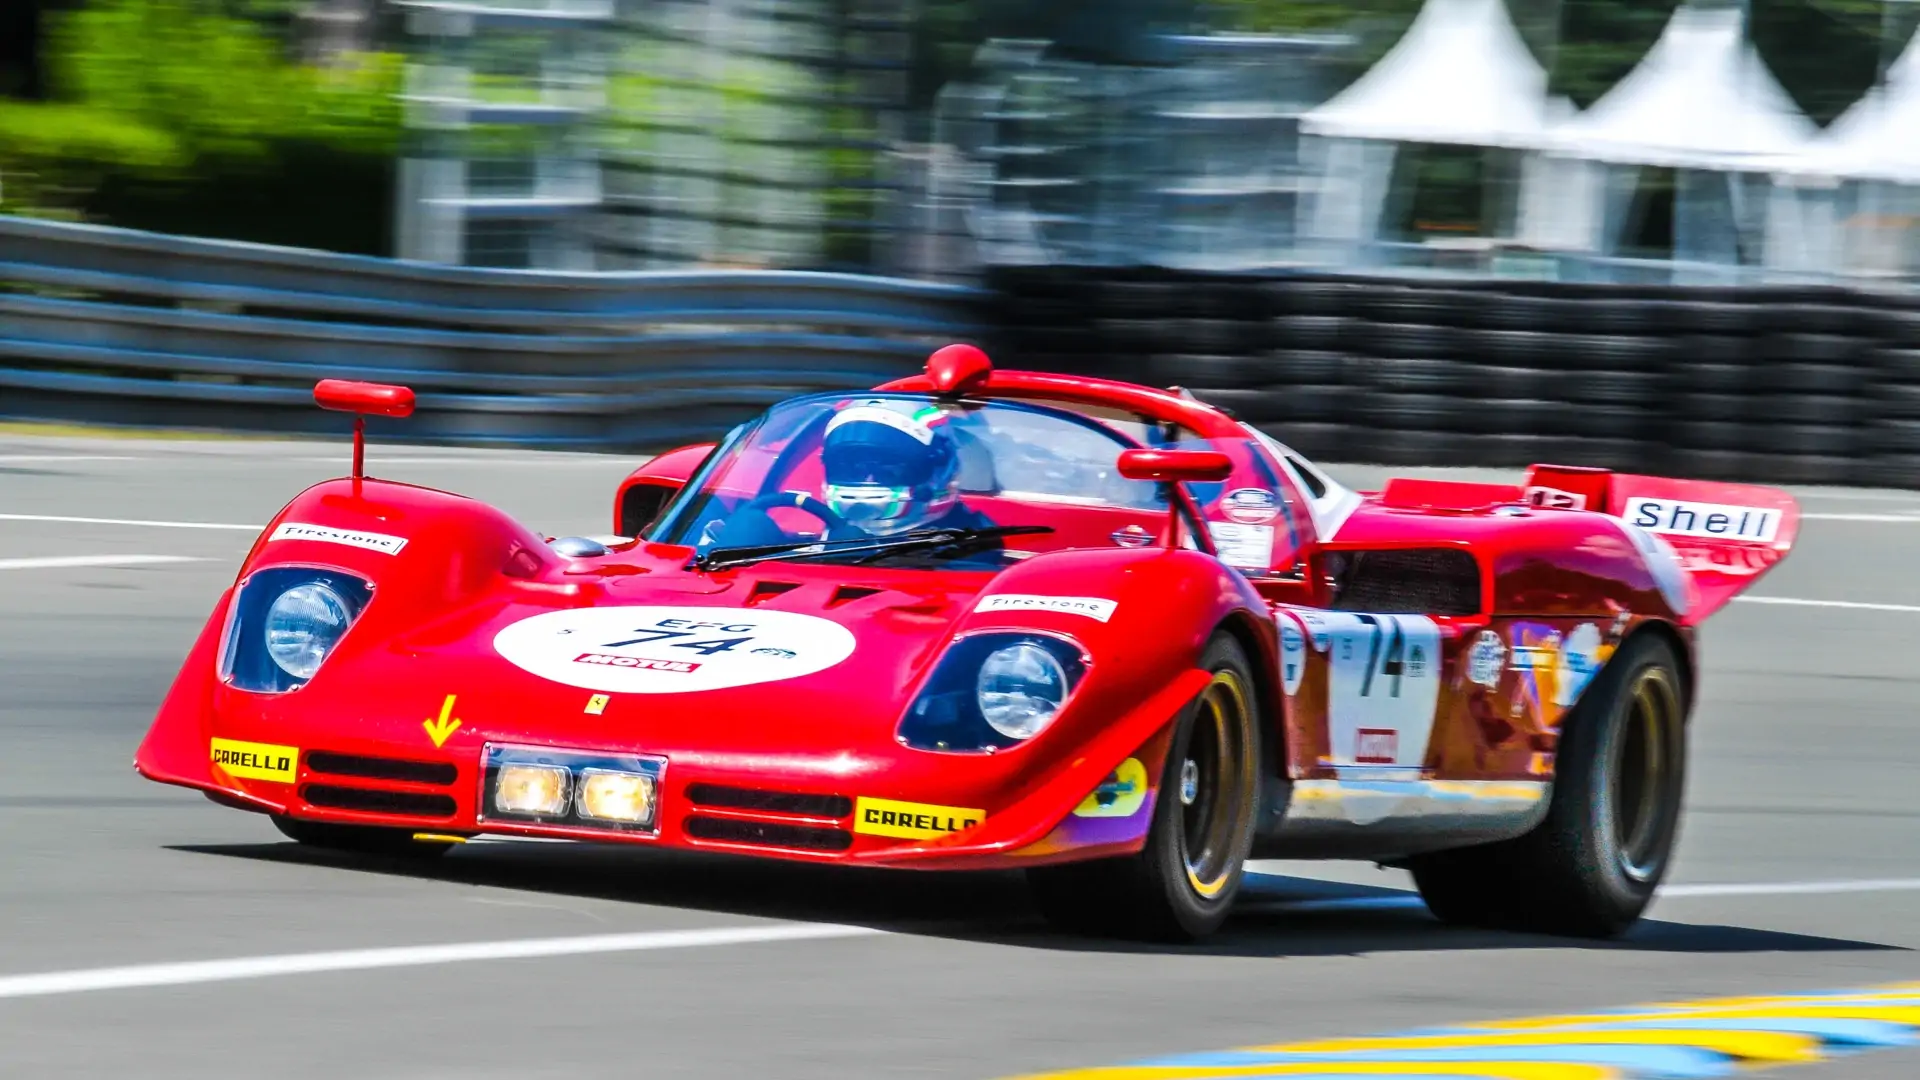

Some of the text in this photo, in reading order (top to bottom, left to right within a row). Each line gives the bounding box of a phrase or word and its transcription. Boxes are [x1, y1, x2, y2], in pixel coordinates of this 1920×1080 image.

[1633, 502, 1769, 537] Shell
[284, 527, 392, 546] Firestone
[991, 598, 1100, 611] Firestone
[600, 628, 756, 656] 74
[578, 653, 698, 672] MOTUL
[214, 748, 291, 772] CARELLO
